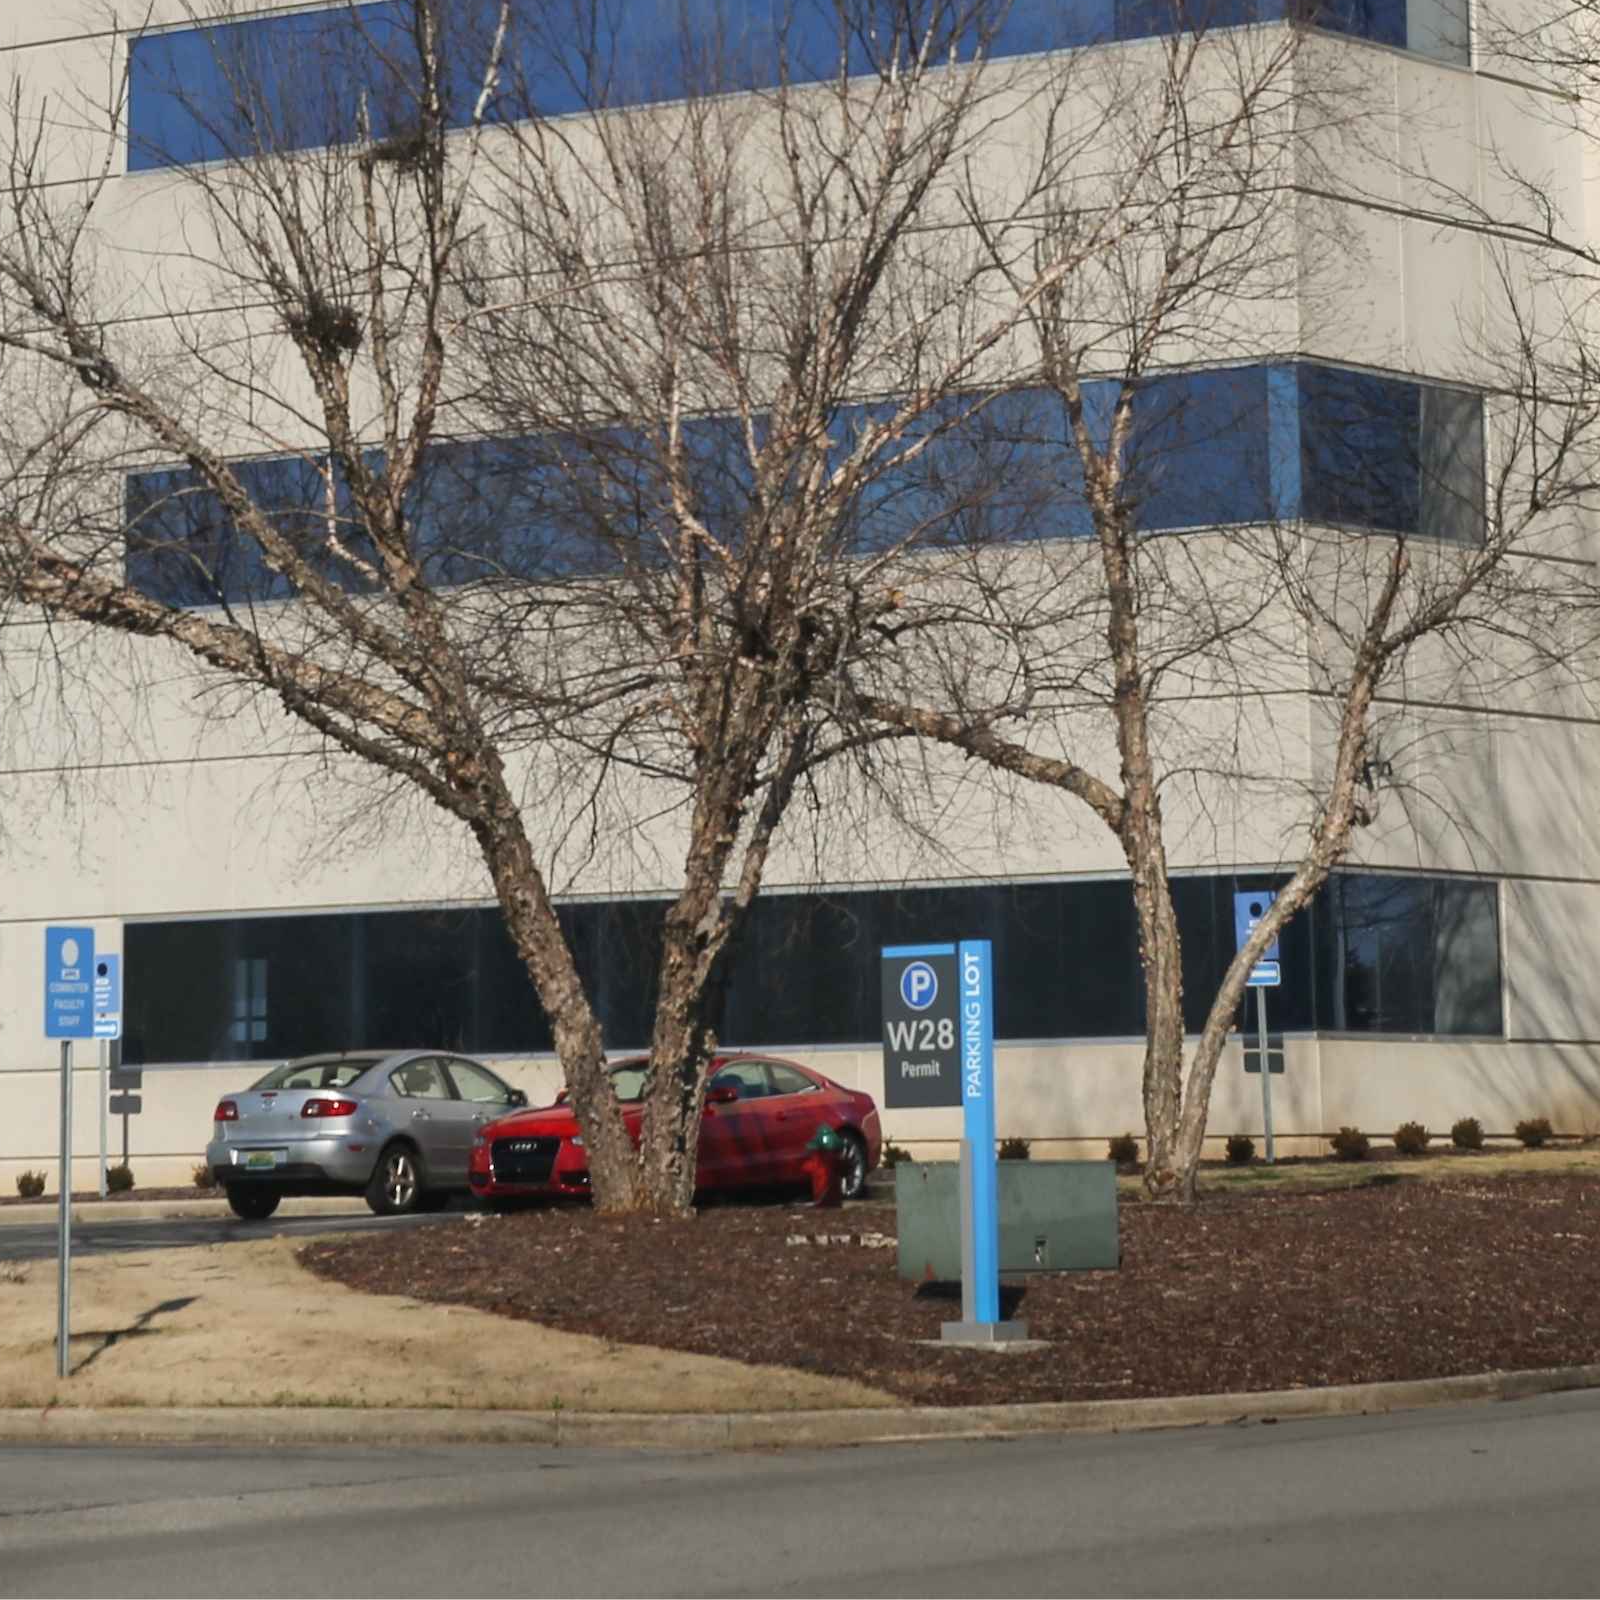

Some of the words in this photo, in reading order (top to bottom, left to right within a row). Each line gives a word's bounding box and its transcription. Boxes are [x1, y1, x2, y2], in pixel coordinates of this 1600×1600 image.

[964, 952, 981, 996] LOT
[886, 1018, 954, 1052] W28
[965, 1002, 982, 1098] PARKING
[901, 1060, 940, 1079] Permit
